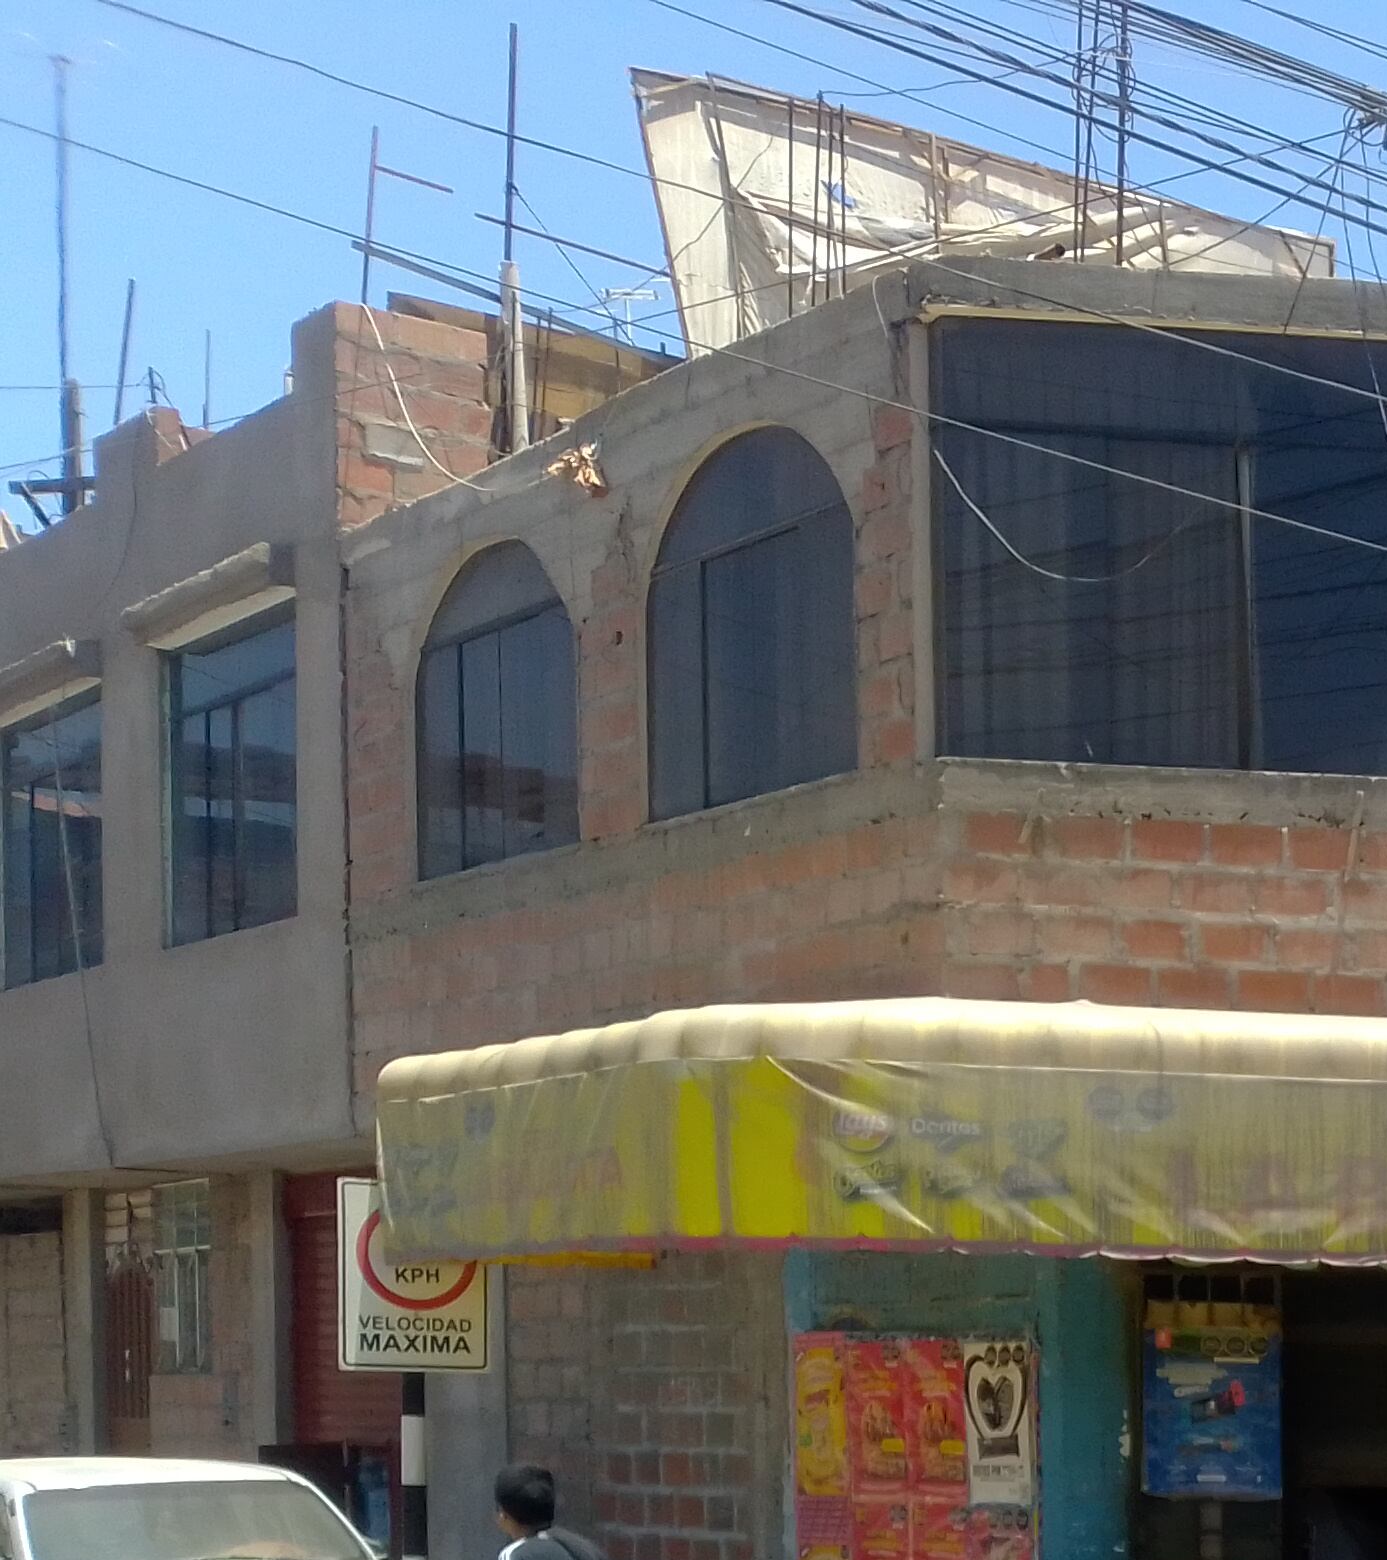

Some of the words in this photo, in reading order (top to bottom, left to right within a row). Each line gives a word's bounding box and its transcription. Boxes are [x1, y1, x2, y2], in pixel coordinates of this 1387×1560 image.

[394, 1267, 440, 1284] KPH
[358, 1314, 472, 1333] VELOCIDAD
[359, 1332, 471, 1354] MAXIMA
